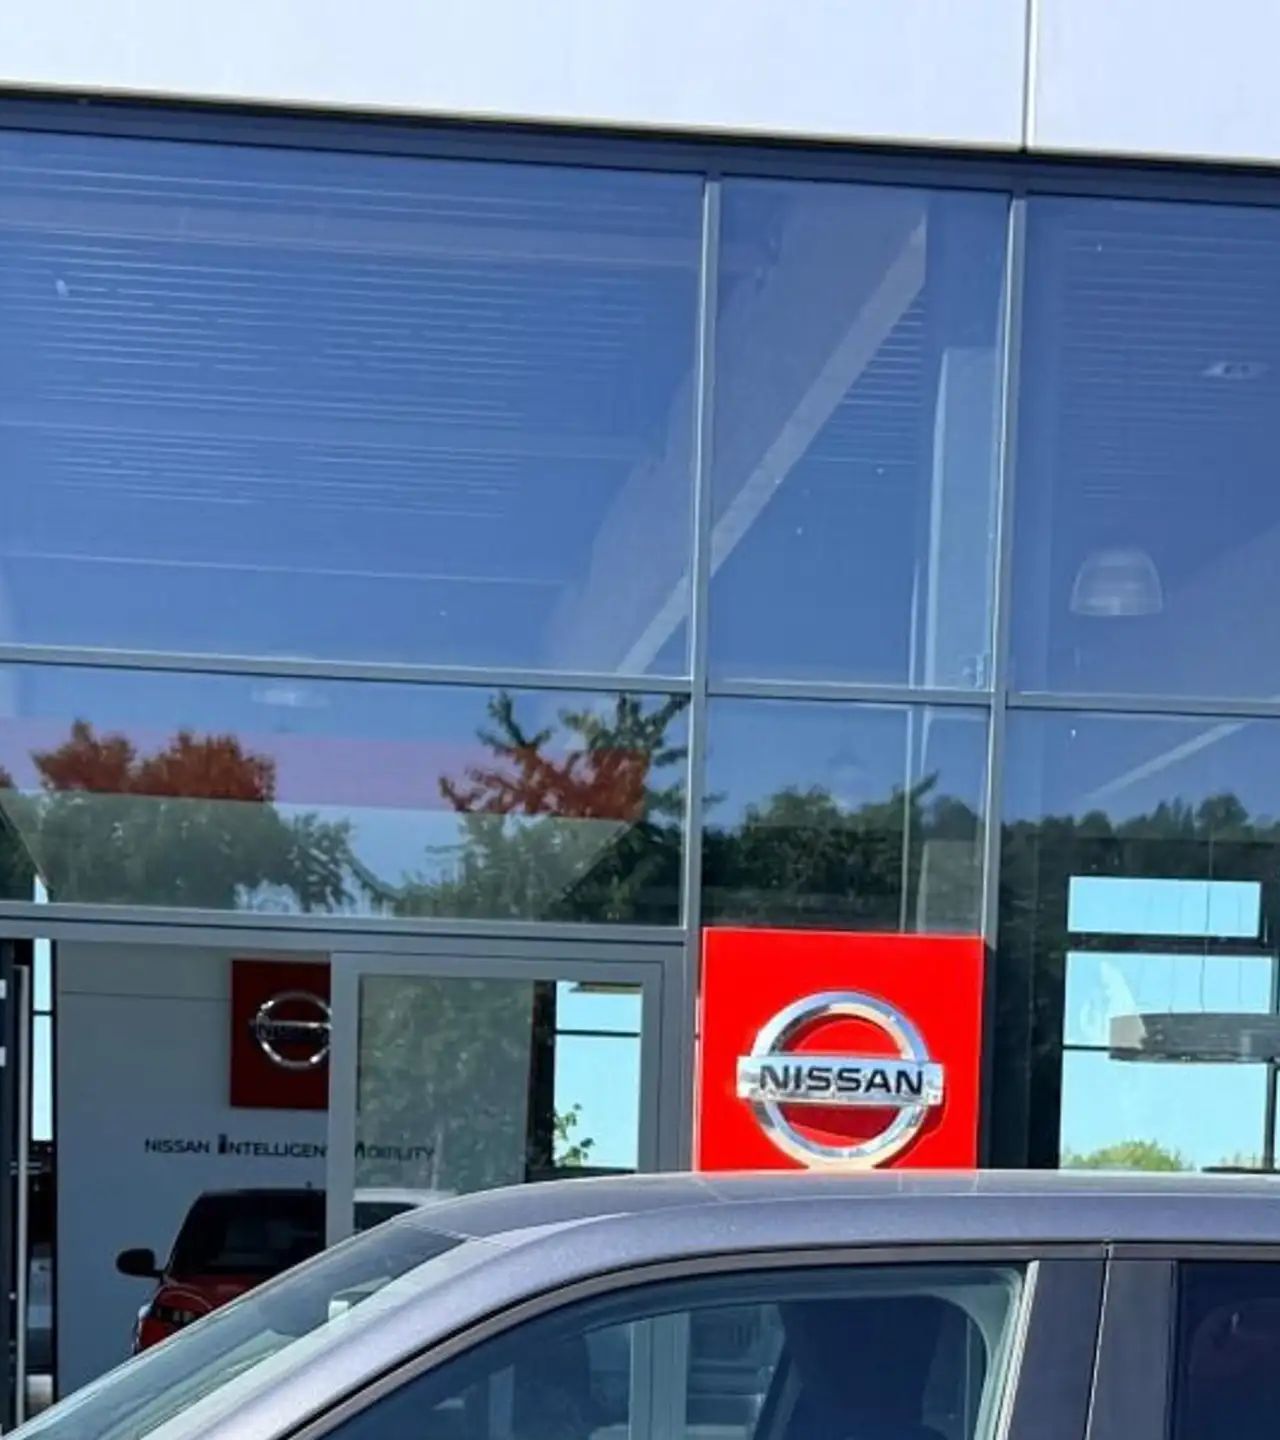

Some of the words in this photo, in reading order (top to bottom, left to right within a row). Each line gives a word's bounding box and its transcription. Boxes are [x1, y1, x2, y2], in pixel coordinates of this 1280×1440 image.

[760, 1064, 923, 1096] NISSAN
[144, 1135, 210, 1154] NISSAN
[217, 1132, 327, 1158] INTELLIGEN
